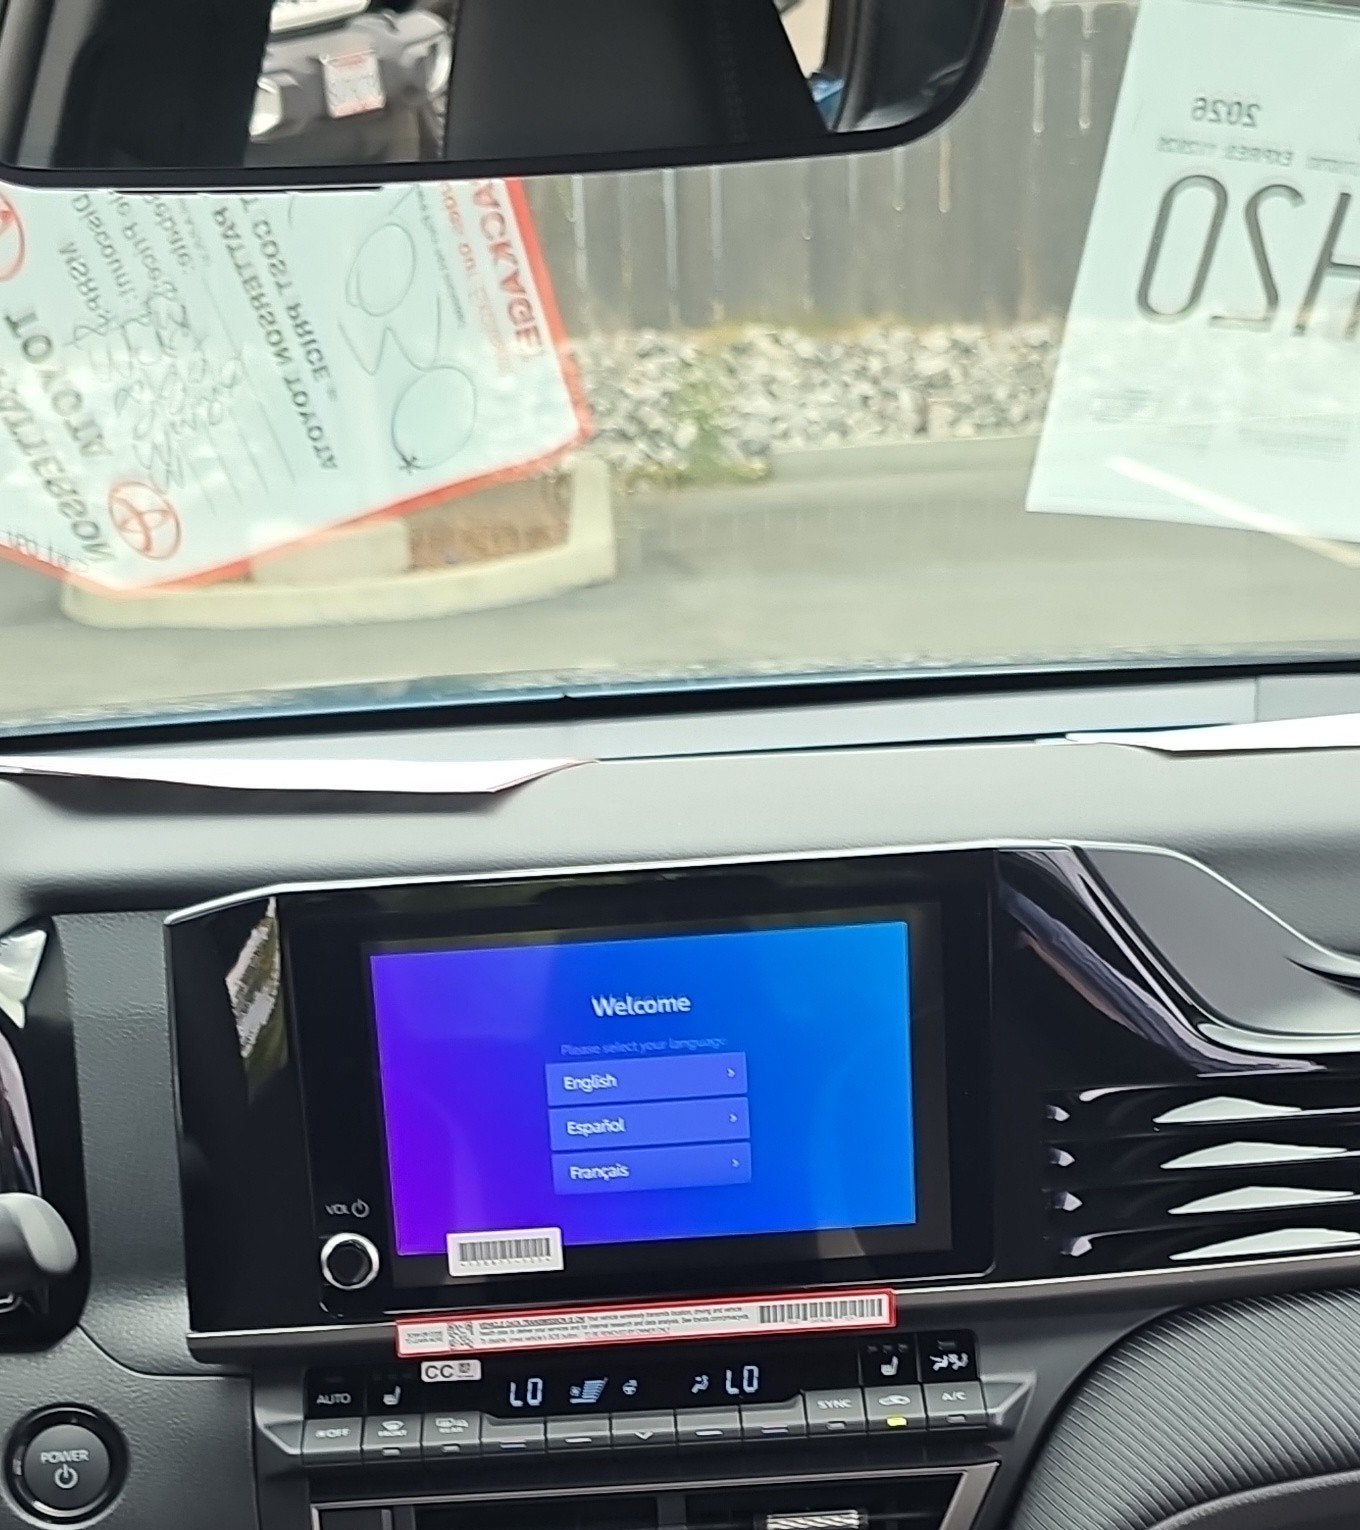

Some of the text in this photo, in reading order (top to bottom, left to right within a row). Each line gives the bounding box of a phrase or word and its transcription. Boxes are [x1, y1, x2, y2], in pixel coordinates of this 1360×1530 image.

[590, 993, 692, 1018] Welcome
[640, 1041, 667, 1054] your
[669, 1037, 727, 1051] language
[562, 1073, 619, 1093] English
[566, 1117, 627, 1138] Español
[569, 1161, 631, 1182] Français
[424, 1363, 455, 1380] CC
[316, 1392, 353, 1405] AUTO
[816, 1397, 854, 1410] SYNC
[941, 1389, 968, 1402] A/C
[40, 1449, 90, 1464] POWER
